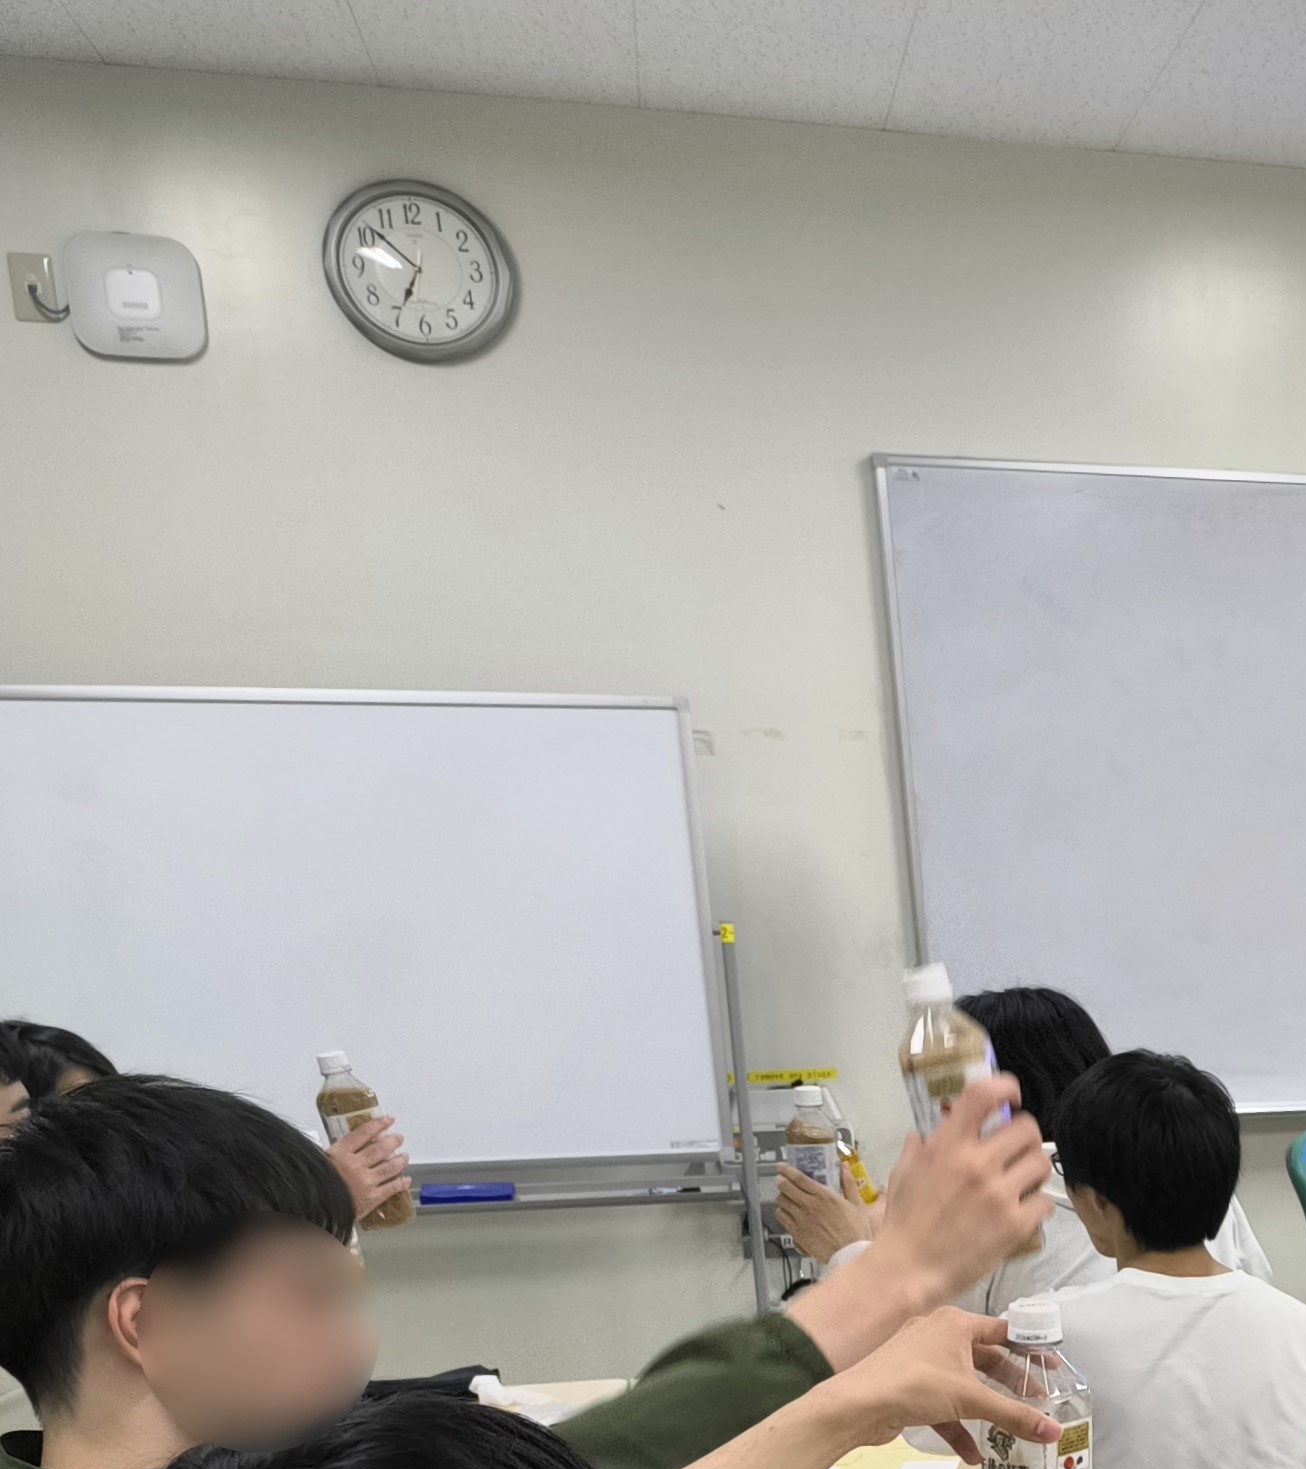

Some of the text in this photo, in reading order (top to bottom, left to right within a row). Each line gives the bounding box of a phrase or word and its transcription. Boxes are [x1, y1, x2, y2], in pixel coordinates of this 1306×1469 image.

[378, 208, 393, 229] 11
[403, 202, 422, 225] 12
[435, 211, 442, 232] 1
[357, 226, 376, 247] 10
[455, 229, 469, 252] 2
[352, 255, 365, 278] 9
[469, 260, 483, 283] 3
[367, 284, 380, 306] 8
[463, 289, 475, 310] 4
[391, 305, 402, 328] 7
[419, 314, 432, 336] 6
[446, 308, 458, 330] 5
